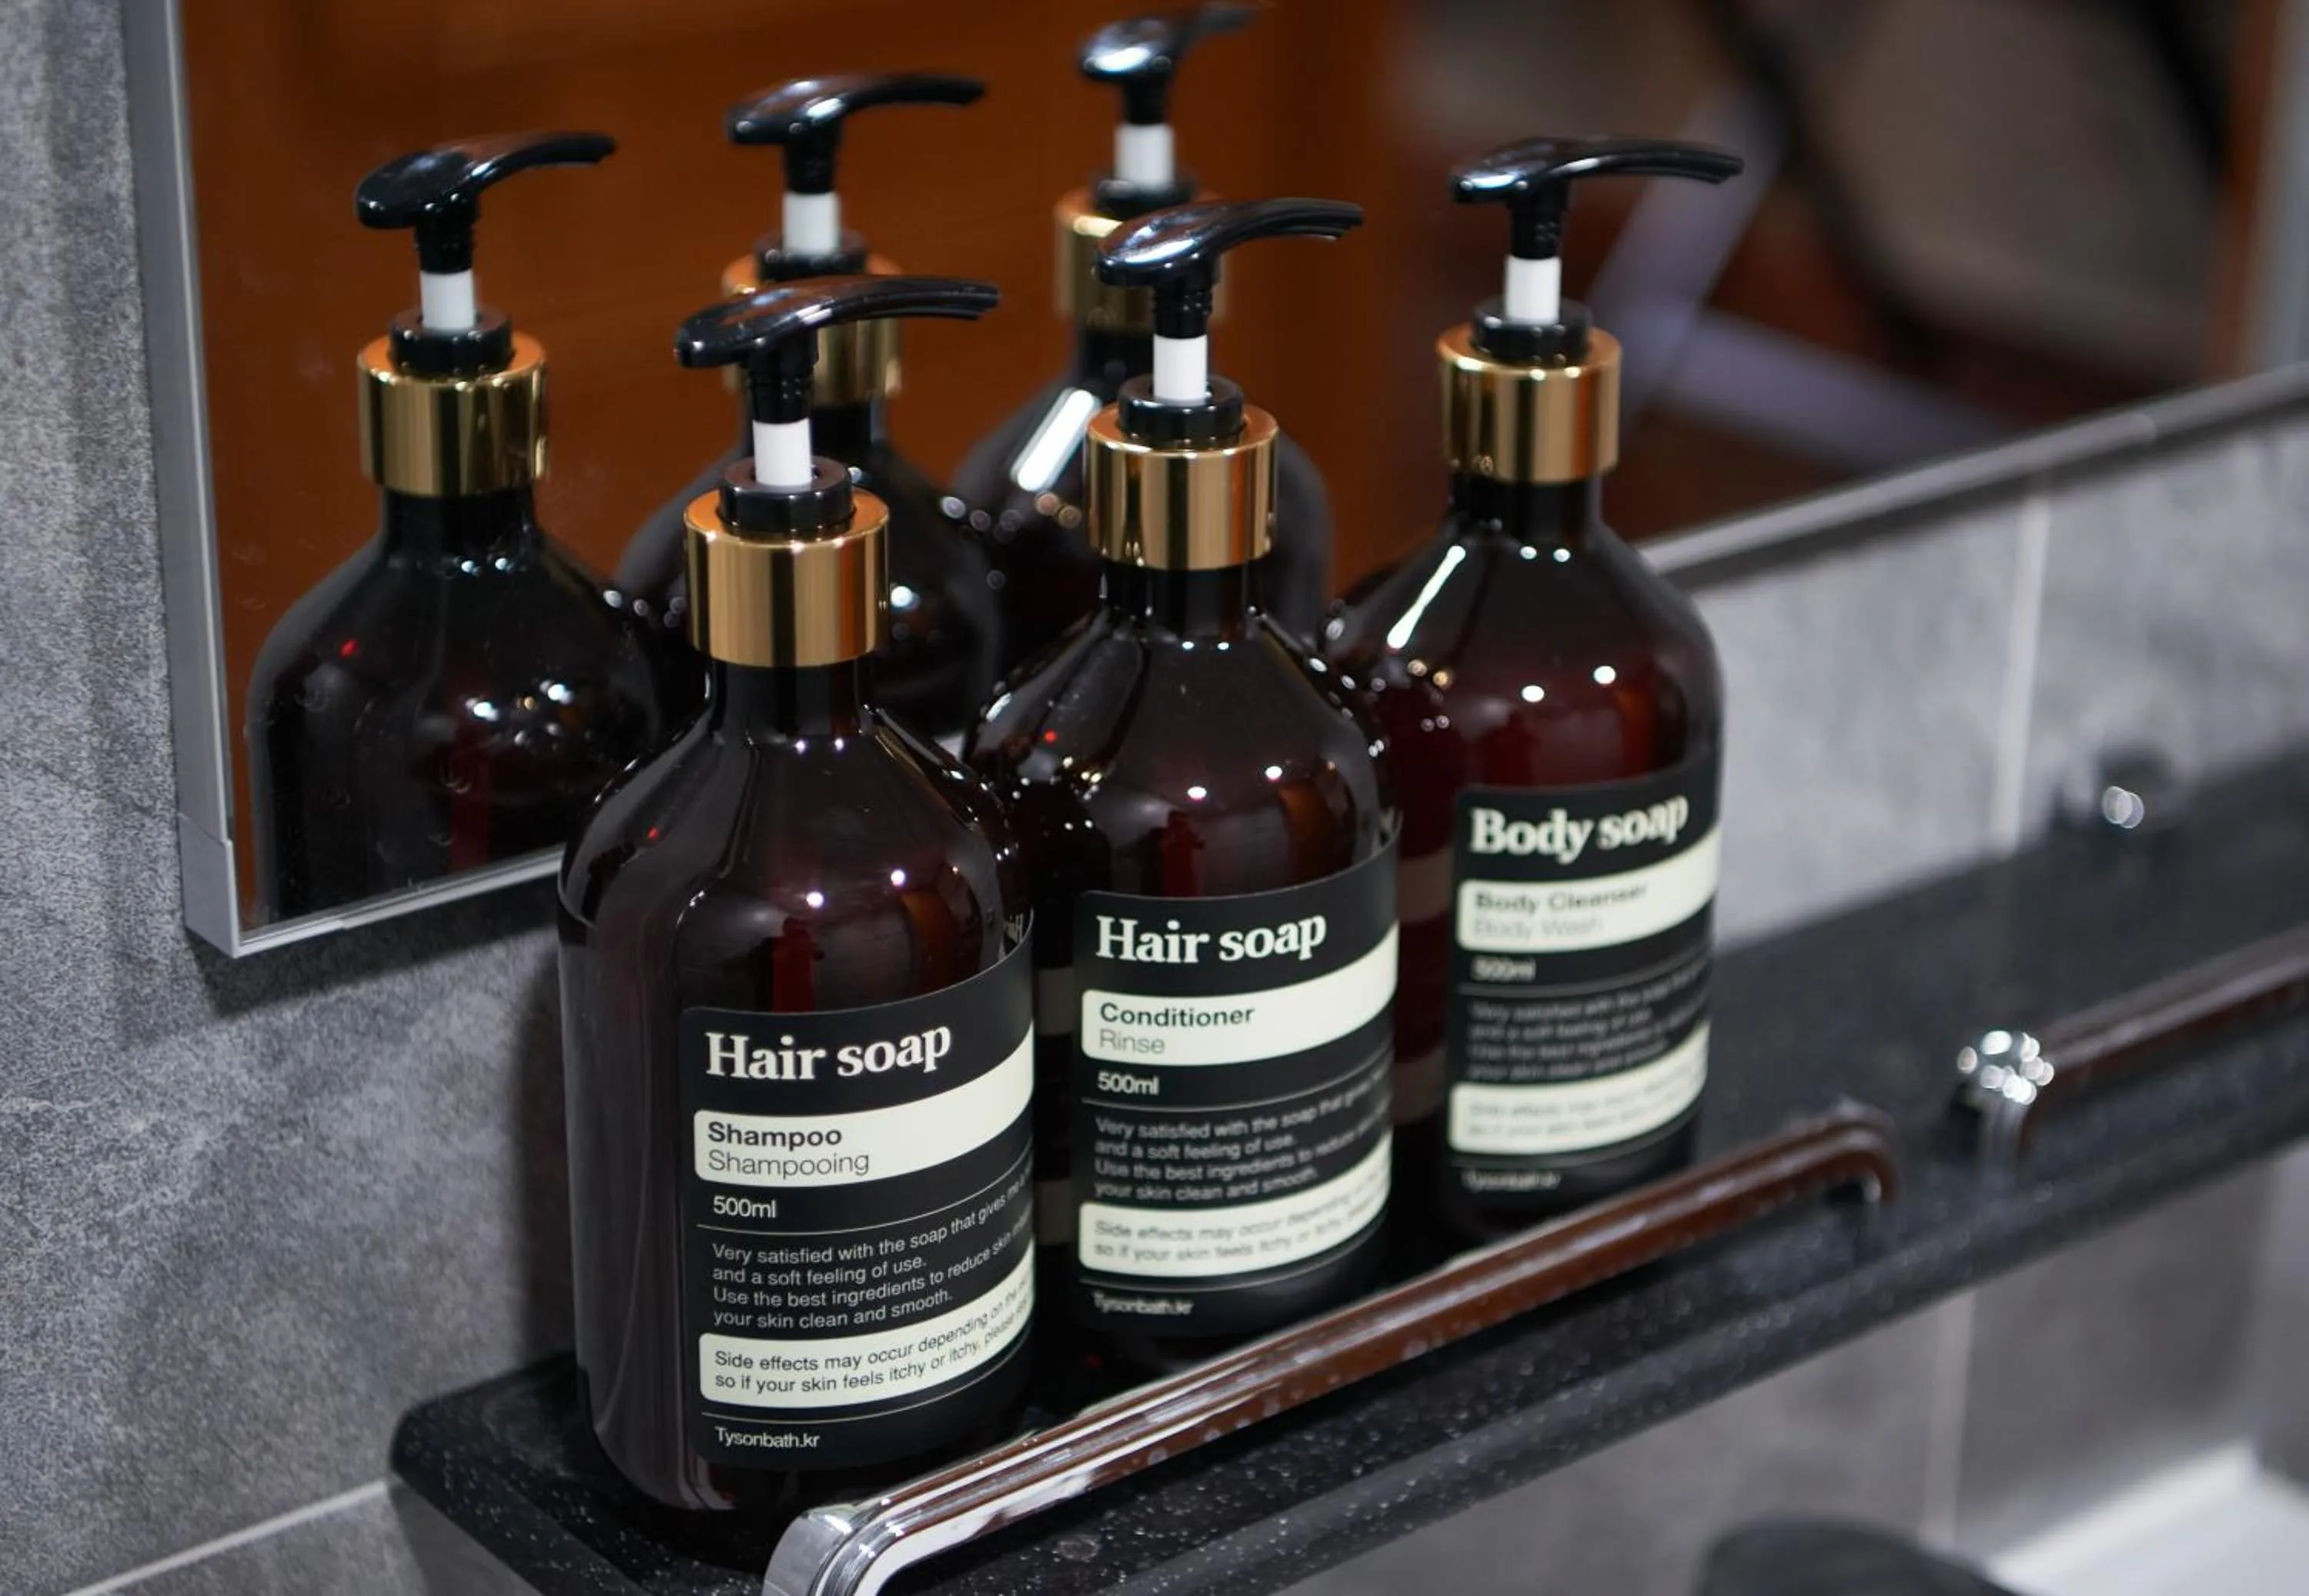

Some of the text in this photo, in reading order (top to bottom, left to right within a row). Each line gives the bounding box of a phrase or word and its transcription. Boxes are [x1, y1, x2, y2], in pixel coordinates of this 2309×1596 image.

[1470, 794, 1689, 865] Body soap
[1476, 891, 1538, 915] Body
[1096, 914, 1328, 963] Hair soap
[1100, 1002, 1255, 1027] Conditioner
[706, 1026, 951, 1080] Hair soap
[1099, 1028, 1165, 1054] Rinse
[1098, 1070, 1159, 1095] 500ml
[708, 1121, 842, 1150] Shampoo
[1094, 1117, 1135, 1140] Very
[1138, 1123, 1211, 1139] satisfied
[1214, 1120, 1248, 1137] with
[1095, 1140, 1128, 1156] and
[1148, 1144, 1181, 1159] soft
[708, 1150, 870, 1180] Shampooing
[1165, 1164, 1203, 1180] best
[713, 1195, 777, 1219] 500ml
[712, 1243, 752, 1266] Very
[757, 1247, 833, 1264] satisfied
[838, 1244, 874, 1260] with
[879, 1239, 906, 1255] the
[910, 1227, 947, 1248] soap
[951, 1213, 976, 1234] that
[978, 1194, 1006, 1224] gives
[713, 1256, 927, 1286] and a soft feeling of use.
[713, 1286, 748, 1304] Use
[754, 1291, 783, 1307] the
[787, 1291, 827, 1307] best
[832, 1277, 926, 1307] ingredients
[929, 1270, 944, 1286] to
[947, 1247, 991, 1279] reduce
[713, 1289, 954, 1329] your skin clean and smooth.
[714, 1351, 754, 1369] Side
[760, 1355, 819, 1371] effects
[824, 1354, 862, 1371] may
[867, 1344, 914, 1364] occur
[918, 1313, 988, 1353] depending
[714, 1374, 737, 1388] so
[741, 1374, 751, 1390] if
[757, 1380, 796, 1395] your
[800, 1377, 837, 1393] skin
[843, 1371, 884, 1389] feels
[889, 1362, 926, 1382] itchy
[931, 1354, 946, 1370] or
[714, 1426, 820, 1448] Tysonbath.kr
